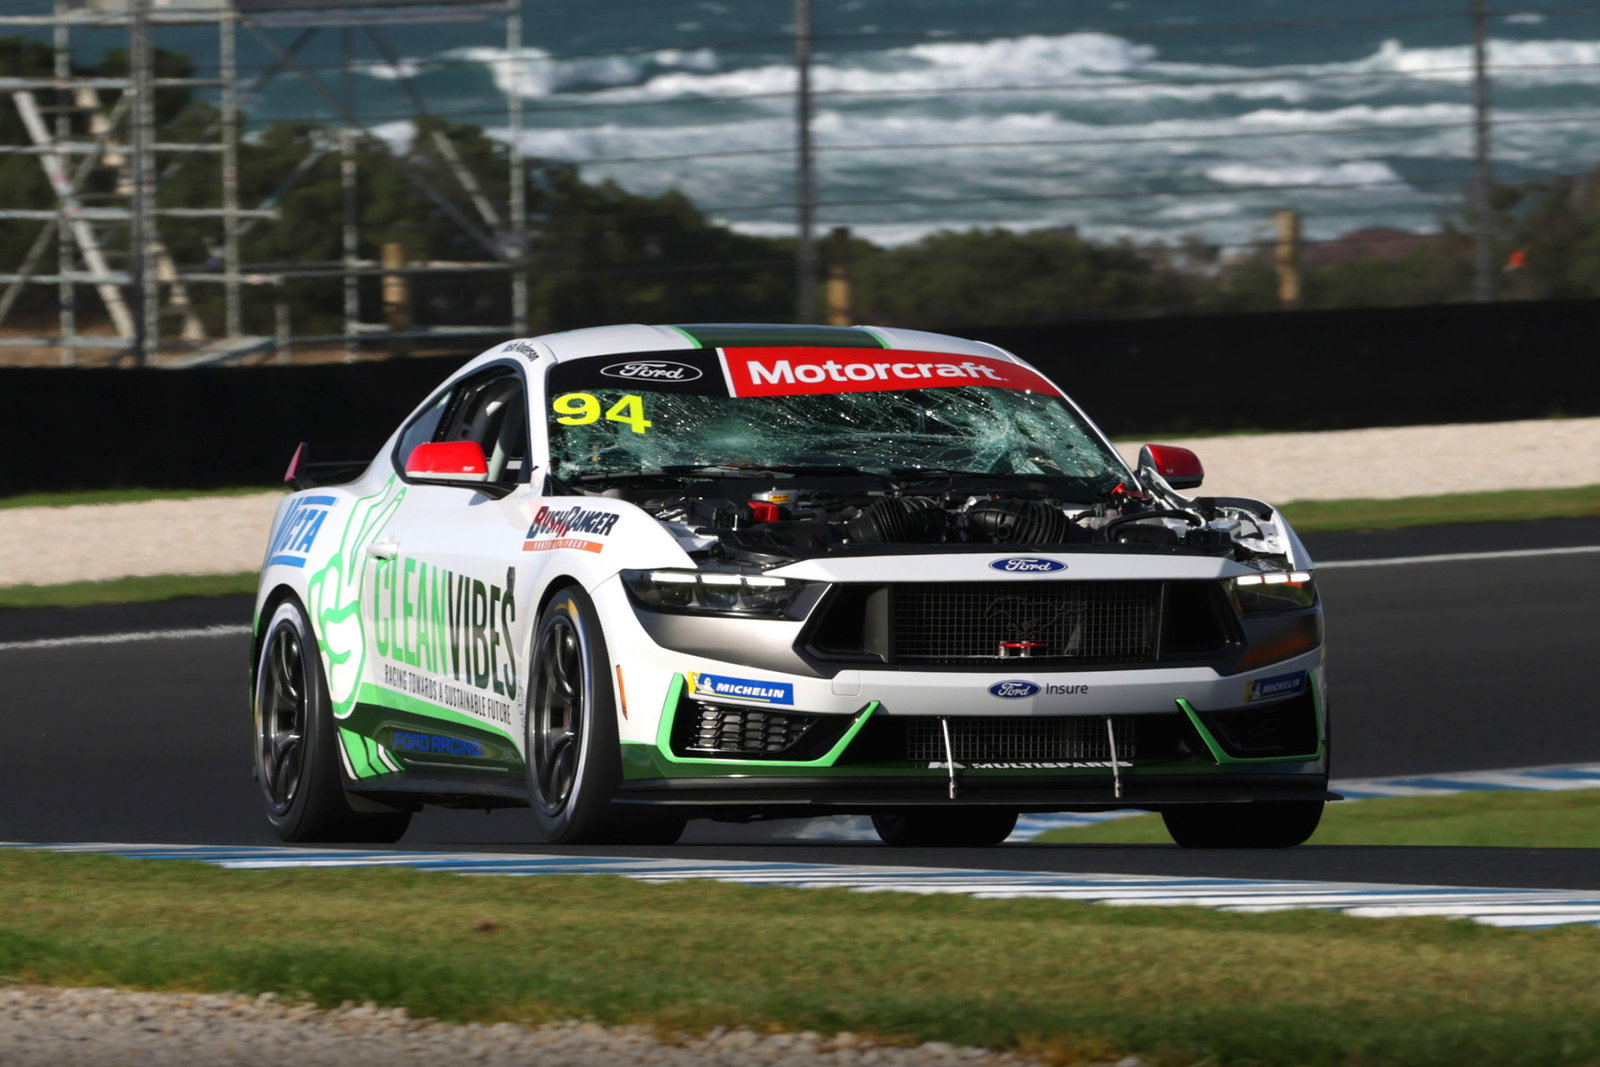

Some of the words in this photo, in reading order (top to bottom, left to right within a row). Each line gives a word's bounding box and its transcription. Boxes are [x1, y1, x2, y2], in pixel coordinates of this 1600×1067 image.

[619, 363, 684, 379] Ford
[746, 360, 1003, 385] Motorcraft
[552, 392, 653, 434] 94
[1005, 559, 1052, 571] Ford
[384, 664, 408, 690] RACING
[408, 672, 437, 701] TOWARDS
[438, 682, 444, 703] A
[444, 684, 486, 717] SUSTAINABLE
[487, 697, 511, 725] FUTURE
[716, 682, 785, 698] MICHELIN
[998, 683, 1030, 696] Ford
[1046, 683, 1088, 694] Insure
[393, 731, 430, 752] FORD
[431, 734, 484, 757] RACING
